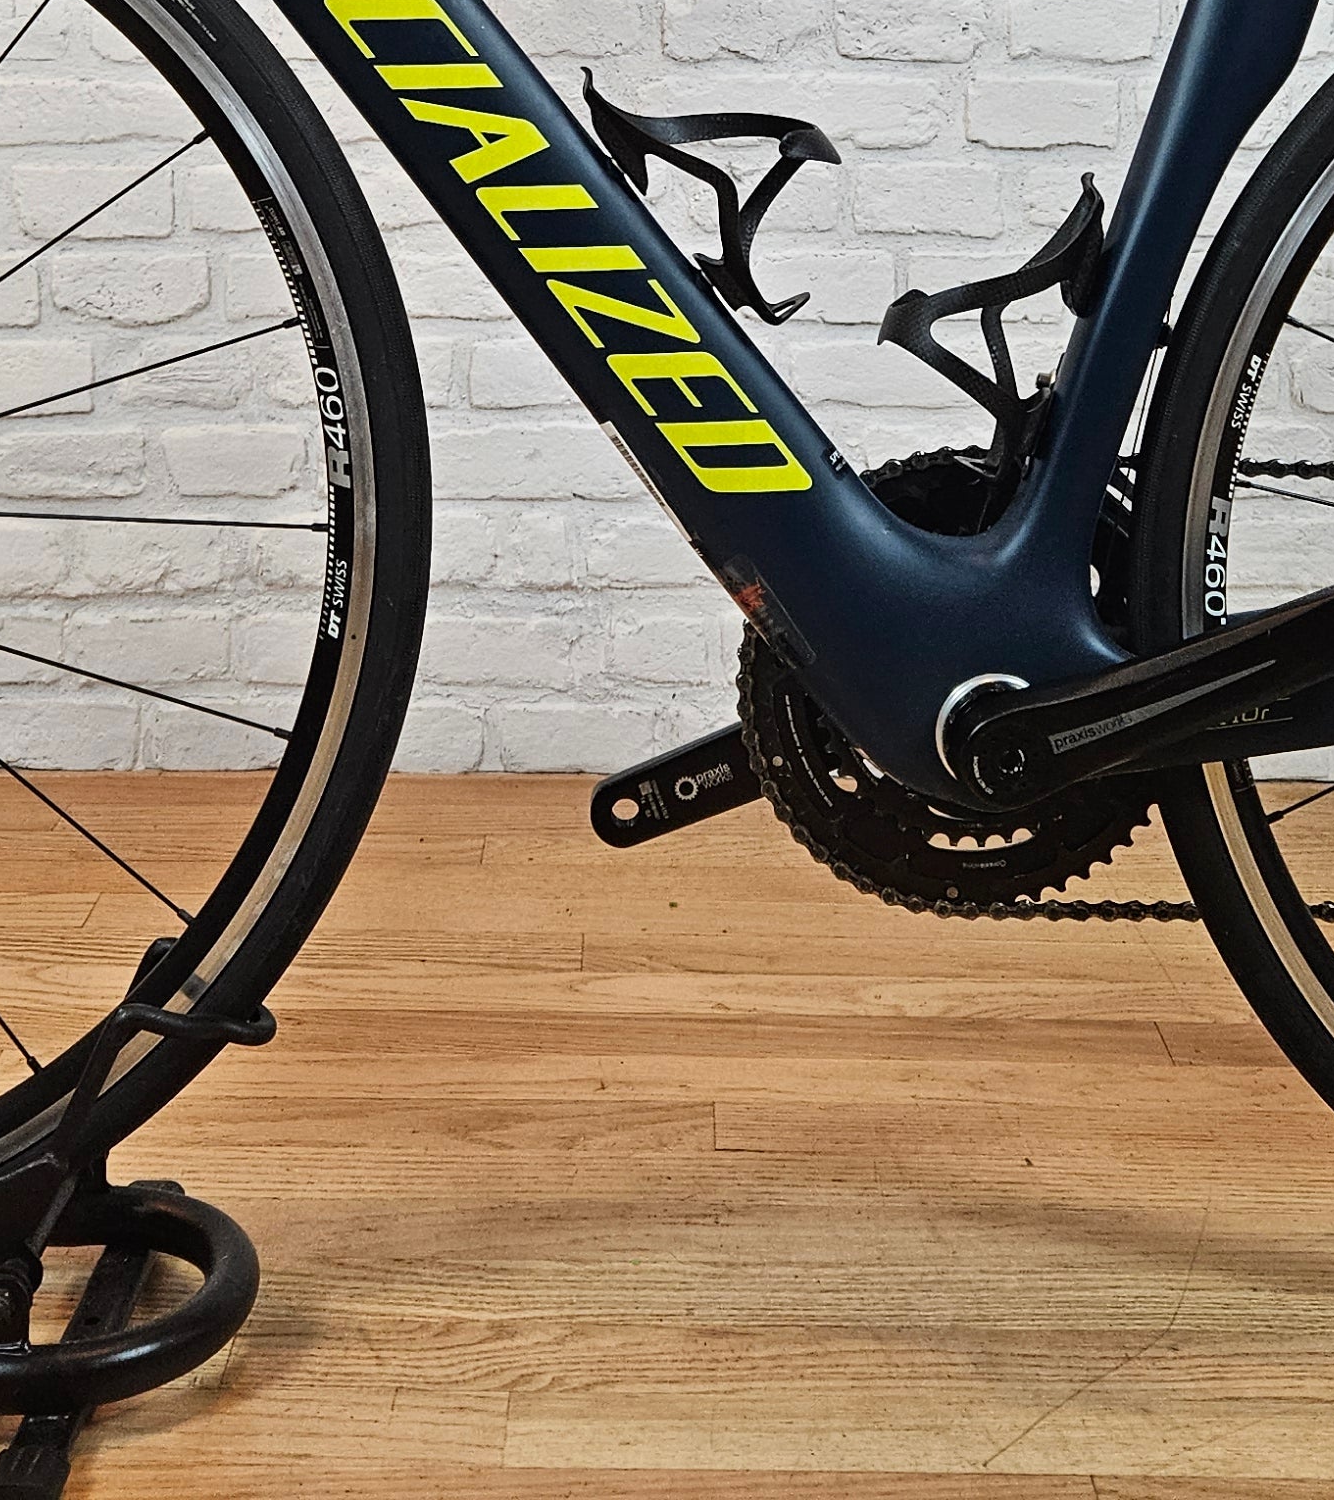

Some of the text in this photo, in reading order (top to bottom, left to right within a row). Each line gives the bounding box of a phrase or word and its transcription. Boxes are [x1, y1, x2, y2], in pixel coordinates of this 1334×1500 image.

[315, 367, 351, 489] R460
[1231, 354, 1262, 429] DT SWISS
[328, 559, 347, 639] DT SWISS
[1205, 496, 1231, 617] R460
